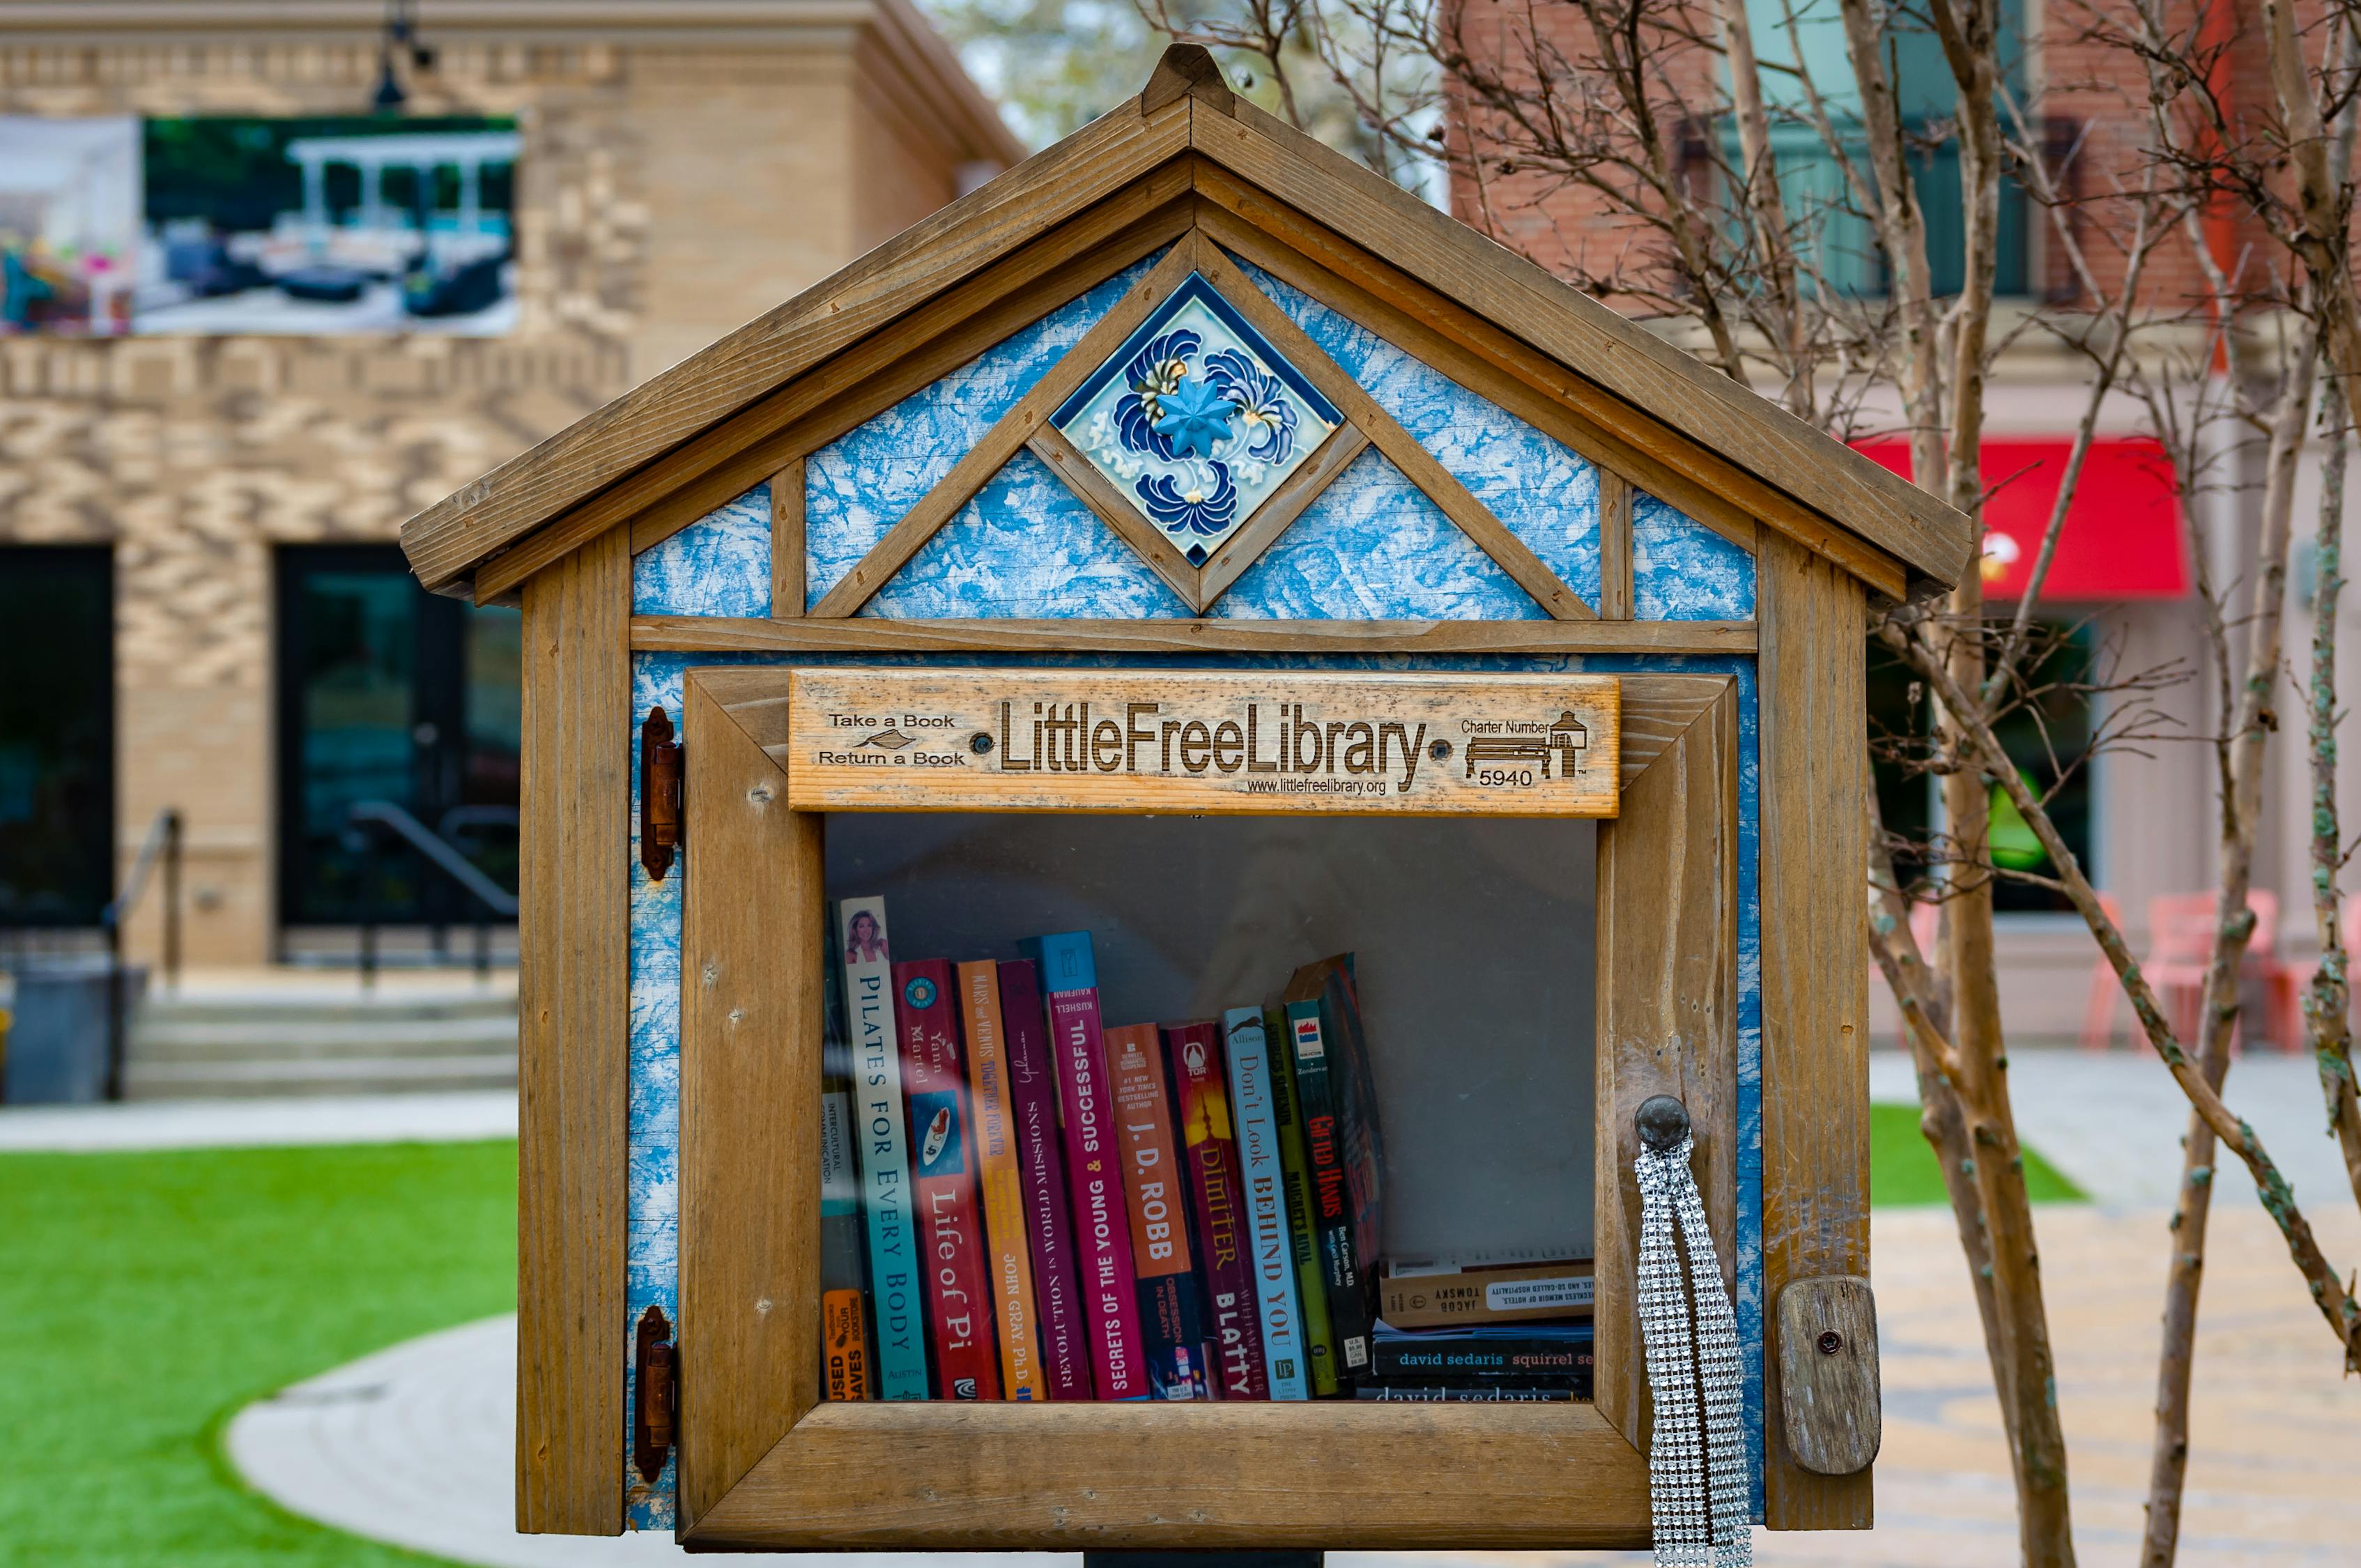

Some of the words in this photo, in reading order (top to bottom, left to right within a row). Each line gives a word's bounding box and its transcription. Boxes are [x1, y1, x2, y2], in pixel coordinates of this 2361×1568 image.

[829, 714, 877, 727] Take
[882, 718, 896, 727] a
[904, 714, 955, 728] Book
[1461, 720, 1503, 735] Charter
[1506, 720, 1550, 734] Number
[819, 751, 886, 764] Return
[894, 755, 906, 765] a
[914, 752, 965, 765] Book
[1001, 702, 1426, 792] LittleFreeLibrary
[1248, 778, 1385, 795] www.littlefreelibrary.org
[1479, 770, 1532, 786] 5940
[971, 975, 989, 1004] MARS
[859, 975, 886, 1086] PILATES
[931, 1031, 941, 1073] Yann
[977, 1020, 994, 1057] VENUS
[1231, 1033, 1263, 1045] Allison
[911, 1024, 928, 1084] Martel
[1070, 1020, 1099, 1153] SUCCESSFUL
[1240, 1056, 1263, 1109] Don't
[828, 1103, 841, 1171] INTERCULTURAL
[871, 1100, 892, 1155] FOR
[1028, 1101, 1047, 1185] MISSIONS
[1246, 1118, 1270, 1169] Look
[1086, 1159, 1102, 1172] &
[877, 1169, 902, 1256] EVERY
[932, 1188, 963, 1260] Life
[1038, 1189, 1055, 1254] WORLD
[1089, 1180, 1112, 1250] YOUNG
[1141, 1182, 1172, 1260] ROBB
[1254, 1175, 1283, 1282] BEHIND
[940, 1268, 968, 1304] of
[1003, 1254, 1020, 1295] JOHN
[1098, 1256, 1116, 1288] THE
[1436, 1286, 1479, 1300] TOMSKY
[1492, 1286, 1531, 1295] HOSPITALITY
[886, 1273, 909, 1350] BODY
[1102, 1293, 1118, 1313] OF
[1158, 1300, 1170, 1339] DEATH
[1166, 1277, 1183, 1344] OBSESSION
[1267, 1292, 1292, 1346] YOU
[1441, 1300, 1476, 1312] JACOB
[1539, 1293, 1563, 1302] MEMOIR
[946, 1312, 972, 1351] Pi
[1049, 1275, 1072, 1388] REVOLUTION
[1216, 1292, 1250, 1394] BLATTY
[831, 1355, 845, 1401] USED
[1106, 1319, 1128, 1391] SECRETS
[1399, 1353, 1443, 1365] david
[1447, 1353, 1504, 1365] sedaris
[1512, 1353, 1573, 1369] squirrel
